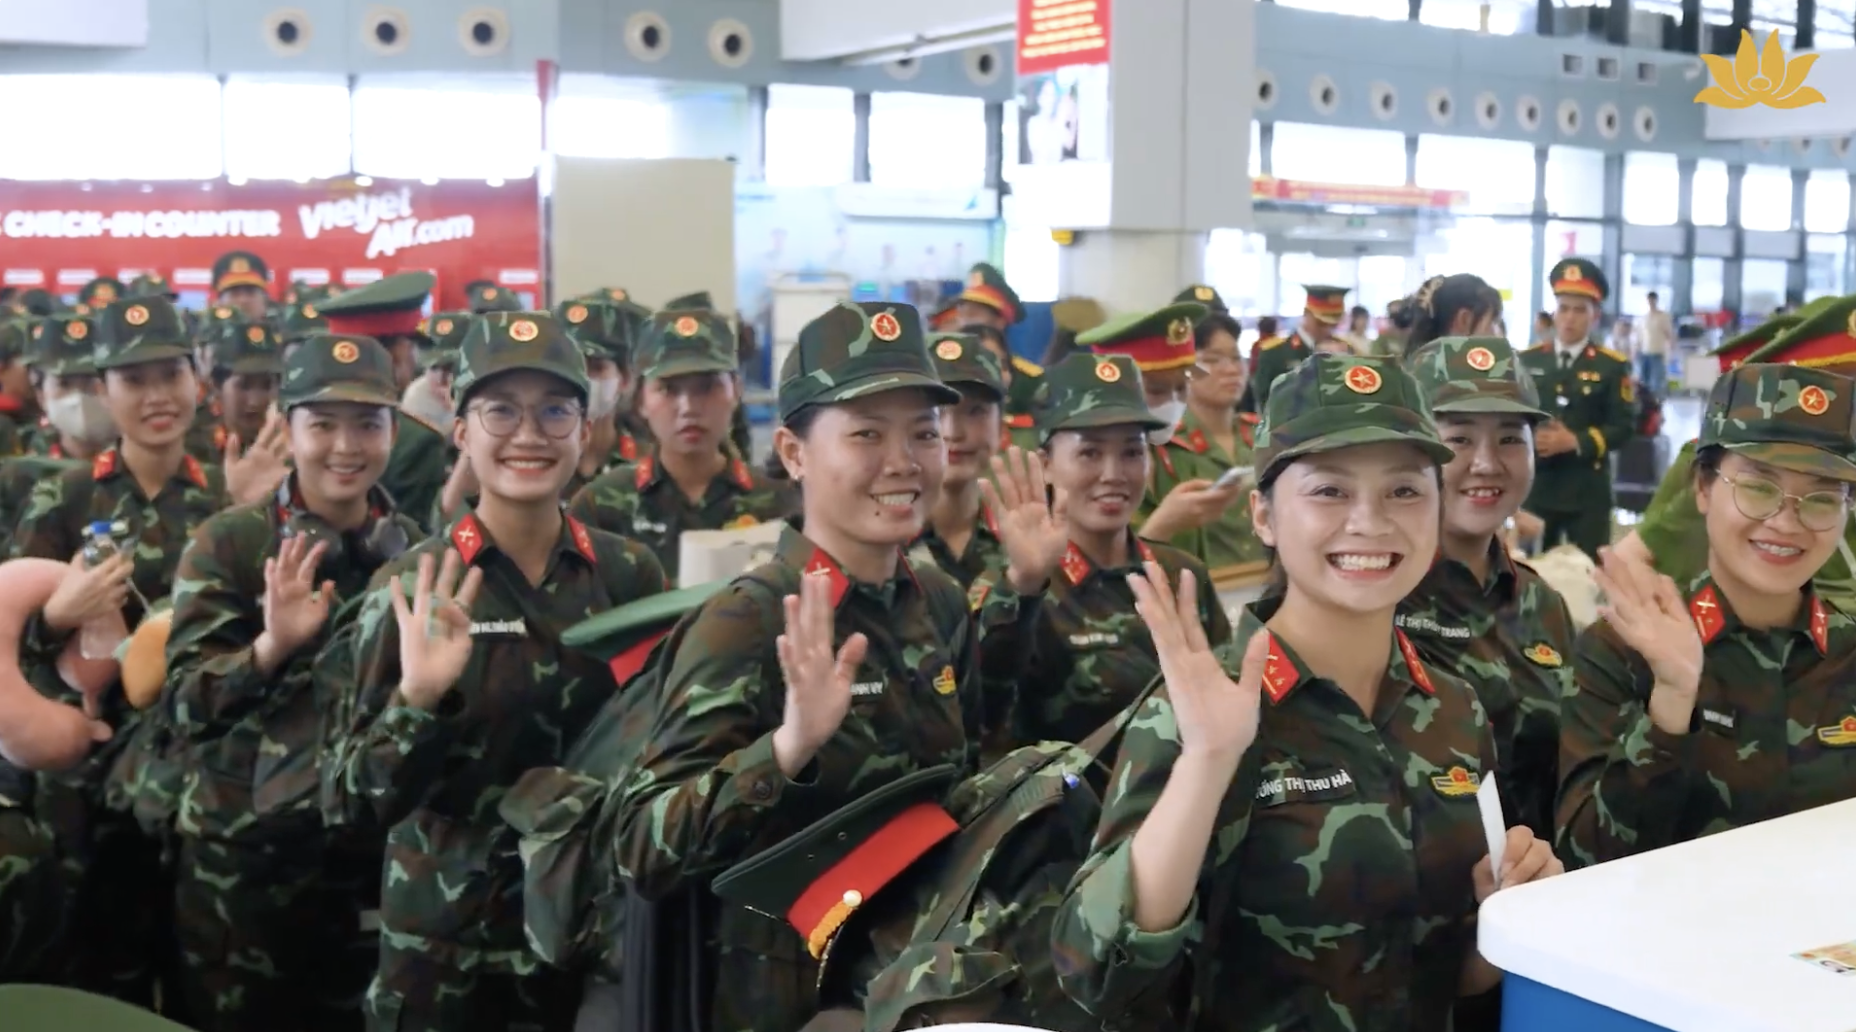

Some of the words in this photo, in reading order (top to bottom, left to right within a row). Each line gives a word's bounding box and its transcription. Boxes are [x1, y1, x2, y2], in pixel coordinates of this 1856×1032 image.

[4, 210, 145, 238] CHECK-IN
[144, 210, 281, 238] COUNTER
[1284, 776, 1306, 793] THỊ
[1305, 778, 1331, 791] THU
[1330, 768, 1353, 788] HÀ
